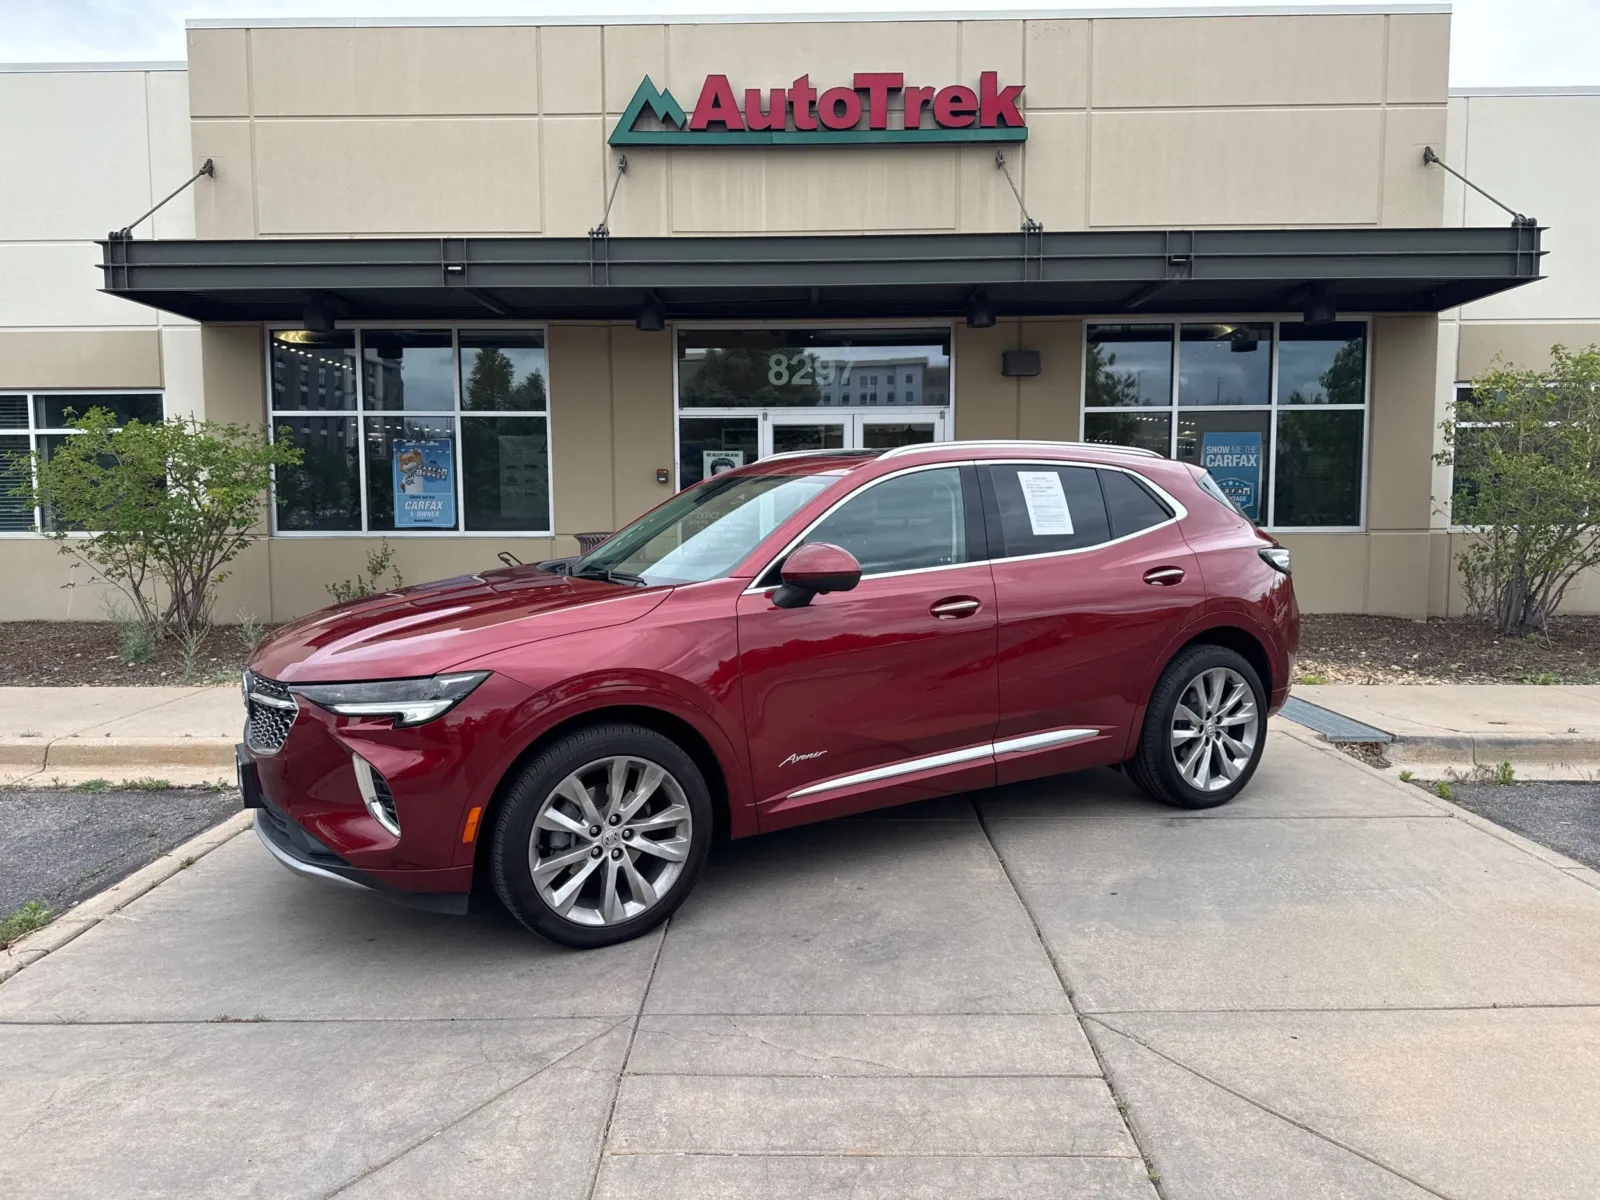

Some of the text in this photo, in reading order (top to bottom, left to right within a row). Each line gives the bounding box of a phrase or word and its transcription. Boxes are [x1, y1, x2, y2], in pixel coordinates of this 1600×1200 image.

[688, 71, 1026, 130] AutoTrek
[767, 353, 857, 386] 8297
[1206, 445, 1257, 454] SHOW ME THE
[1206, 454, 1257, 467] CARFAX
[405, 500, 444, 510] CARFAX
